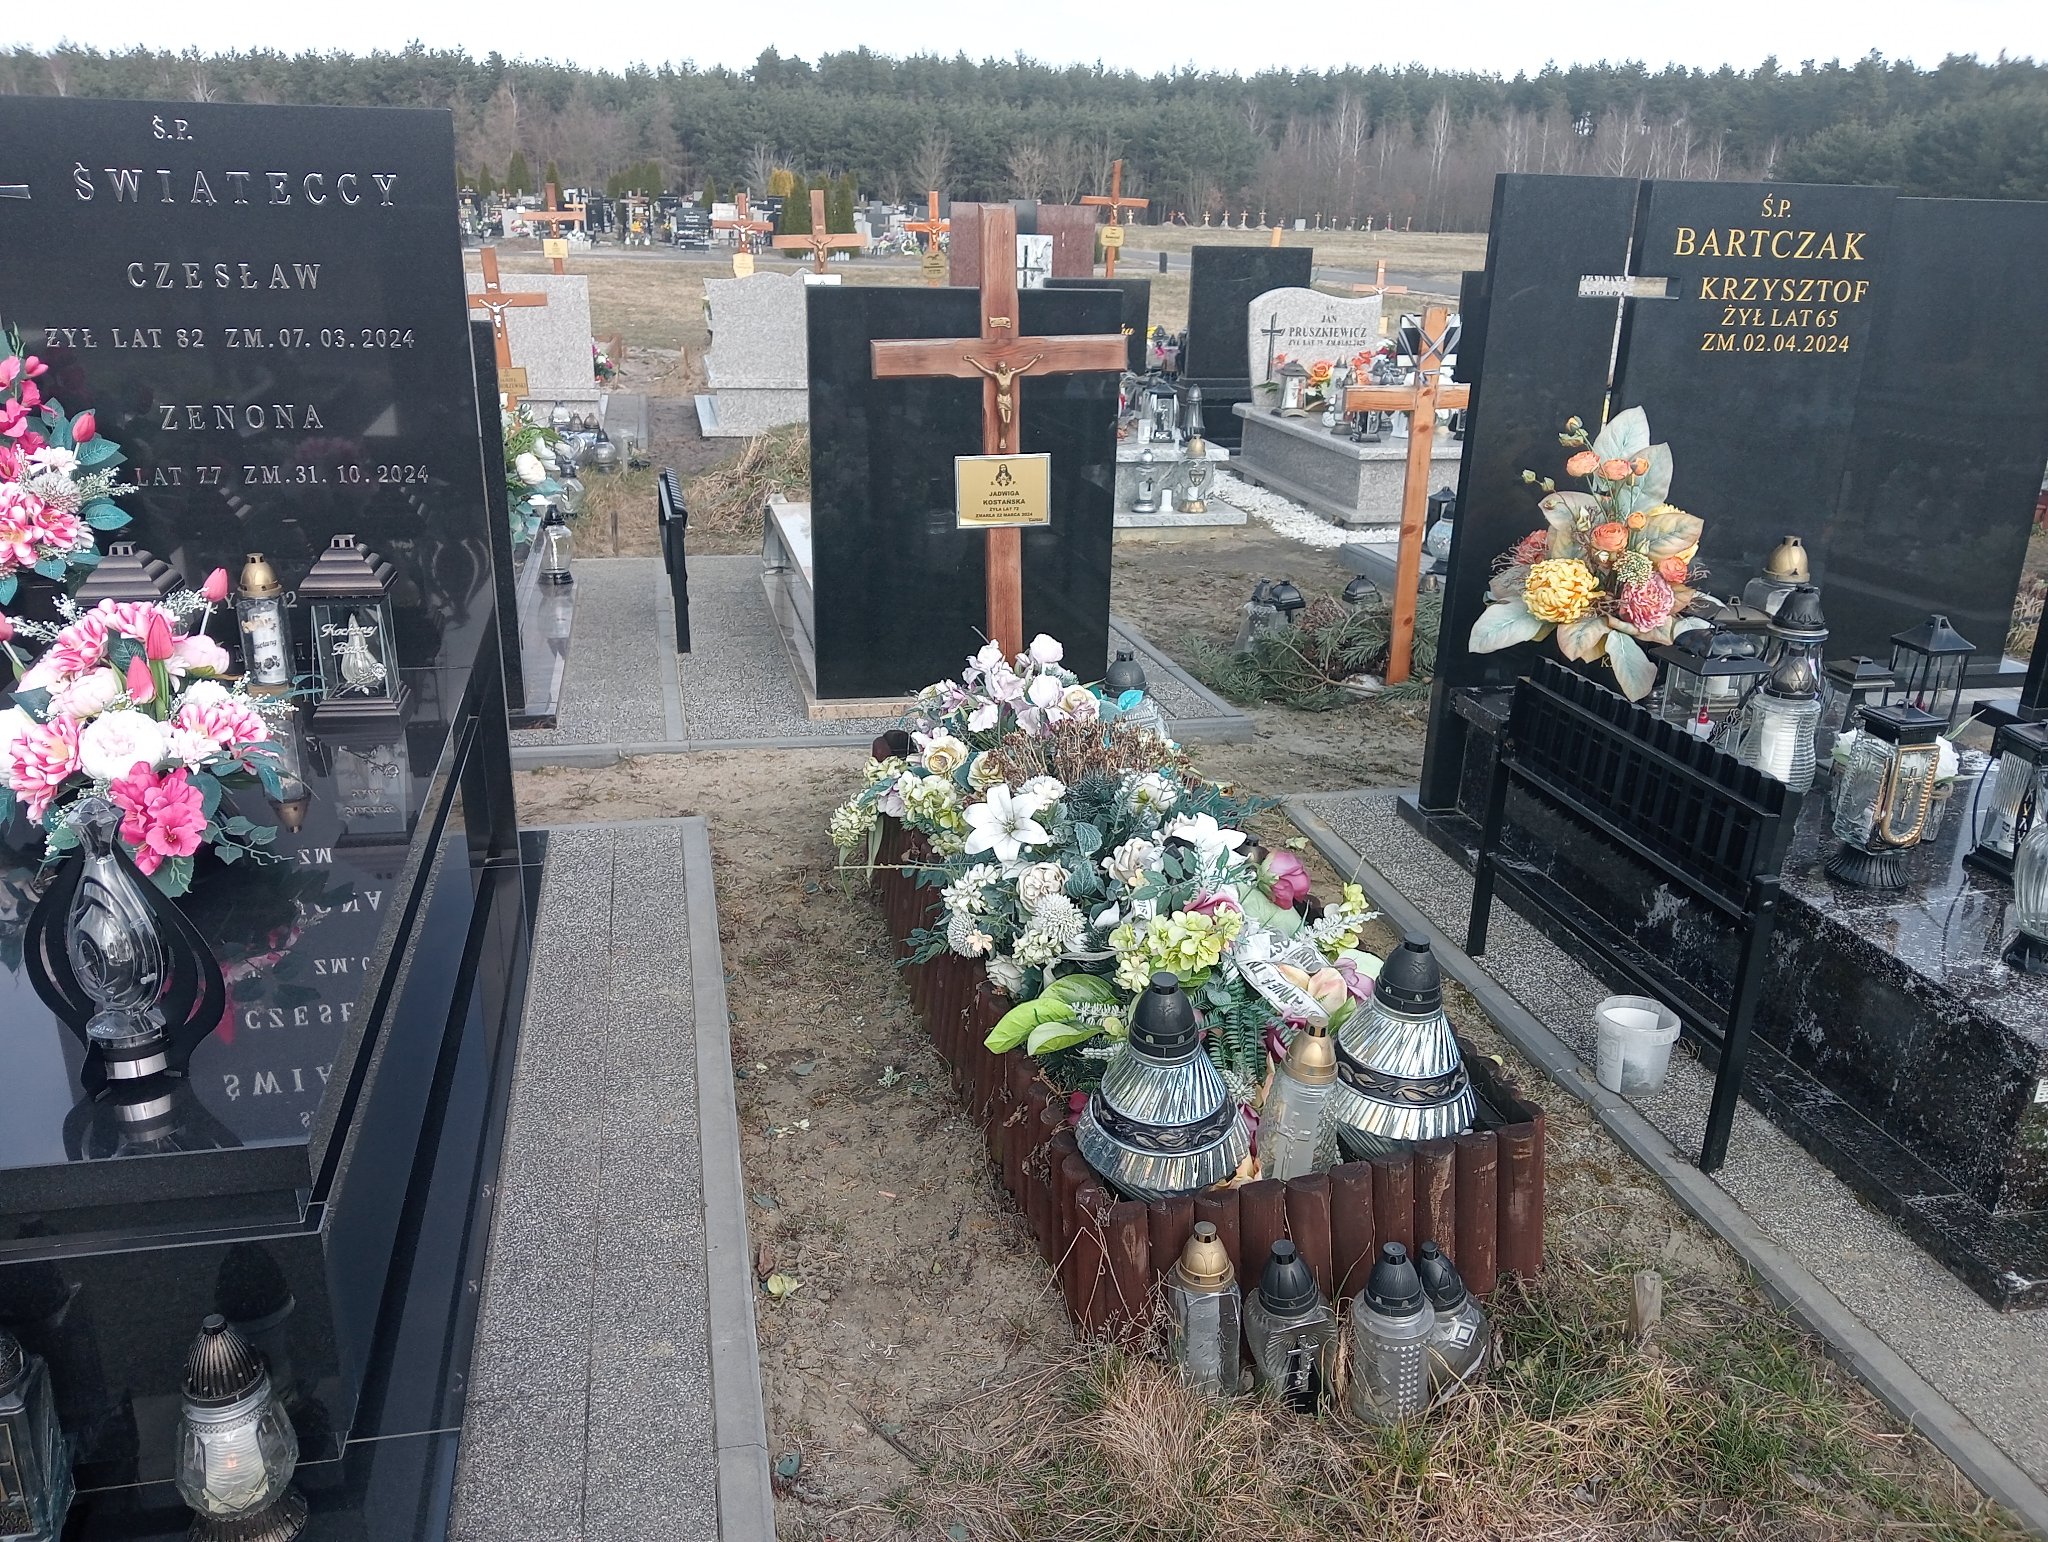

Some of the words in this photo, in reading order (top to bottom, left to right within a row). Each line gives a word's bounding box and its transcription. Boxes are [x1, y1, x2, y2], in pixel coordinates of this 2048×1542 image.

[152, 114, 193, 141] Ś.P.
[73, 161, 397, 207] ŚWIĄTECCY
[1761, 192, 1791, 218] Ś.P.
[1673, 227, 1866, 261] BARTCZAK
[126, 262, 321, 290] CZESŁAW
[1698, 276, 1870, 303] KRZYSZTOF
[1321, 314, 1337, 323] JAN
[1721, 304, 1765, 326] ŻYŁ
[1770, 309, 1813, 327] LAT
[1815, 310, 1839, 328] 65
[111, 328, 162, 348] LAT
[176, 328, 205, 348] 82
[1288, 326, 1367, 338] PRUSZKIEWICZ
[1701, 333, 1850, 353] ZM.02.04.2024
[158, 403, 324, 431] ZENONA
[134, 467, 182, 487] LAT
[196, 466, 222, 485] 77
